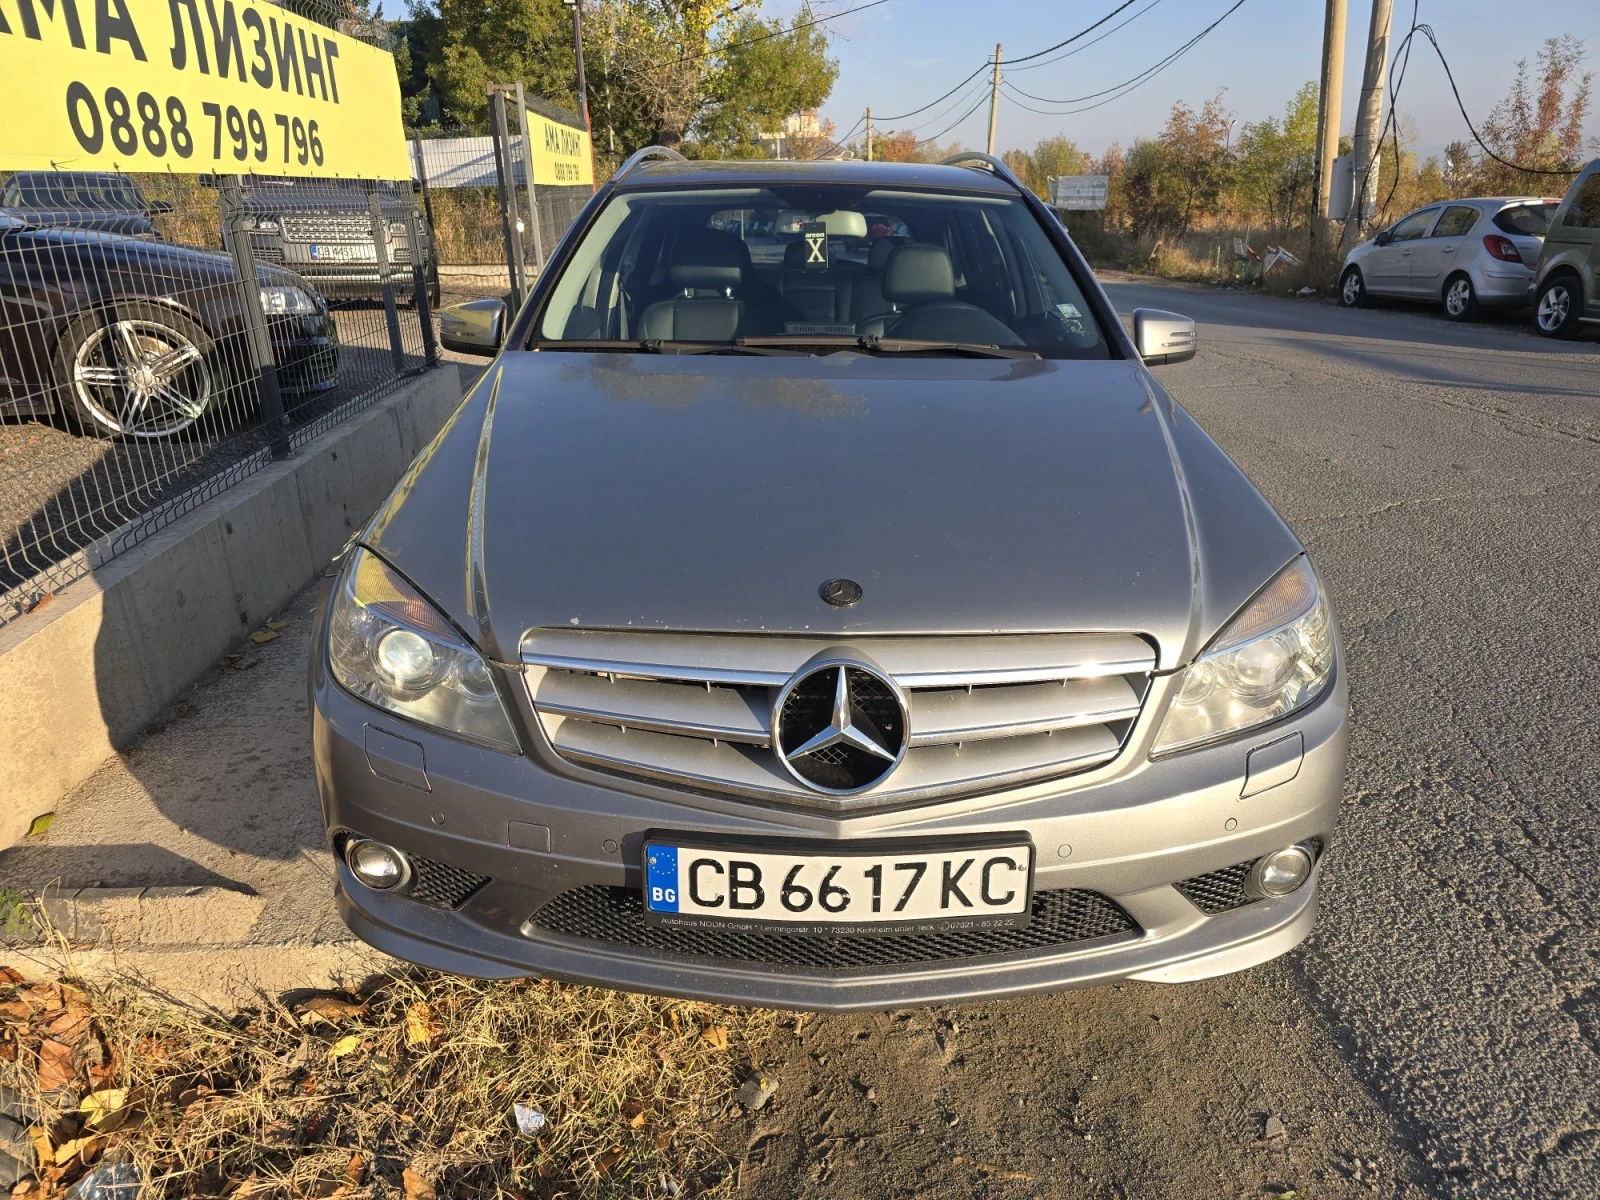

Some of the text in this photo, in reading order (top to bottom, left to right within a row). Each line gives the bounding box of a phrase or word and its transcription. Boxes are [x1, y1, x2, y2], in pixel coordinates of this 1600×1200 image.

[0, 0, 340, 104] МА ЛИЗИНГ
[66, 80, 325, 167] 0888 799 796
[544, 123, 561, 155] АМА
[806, 238, 826, 263] X
[652, 886, 676, 903] BG
[688, 856, 1018, 913] CB 6617 KC
[661, 917, 698, 927] Autohaus
[813, 926, 823, 934] 10
[993, 918, 1003, 928] 22
[1004, 917, 1015, 927] 22
